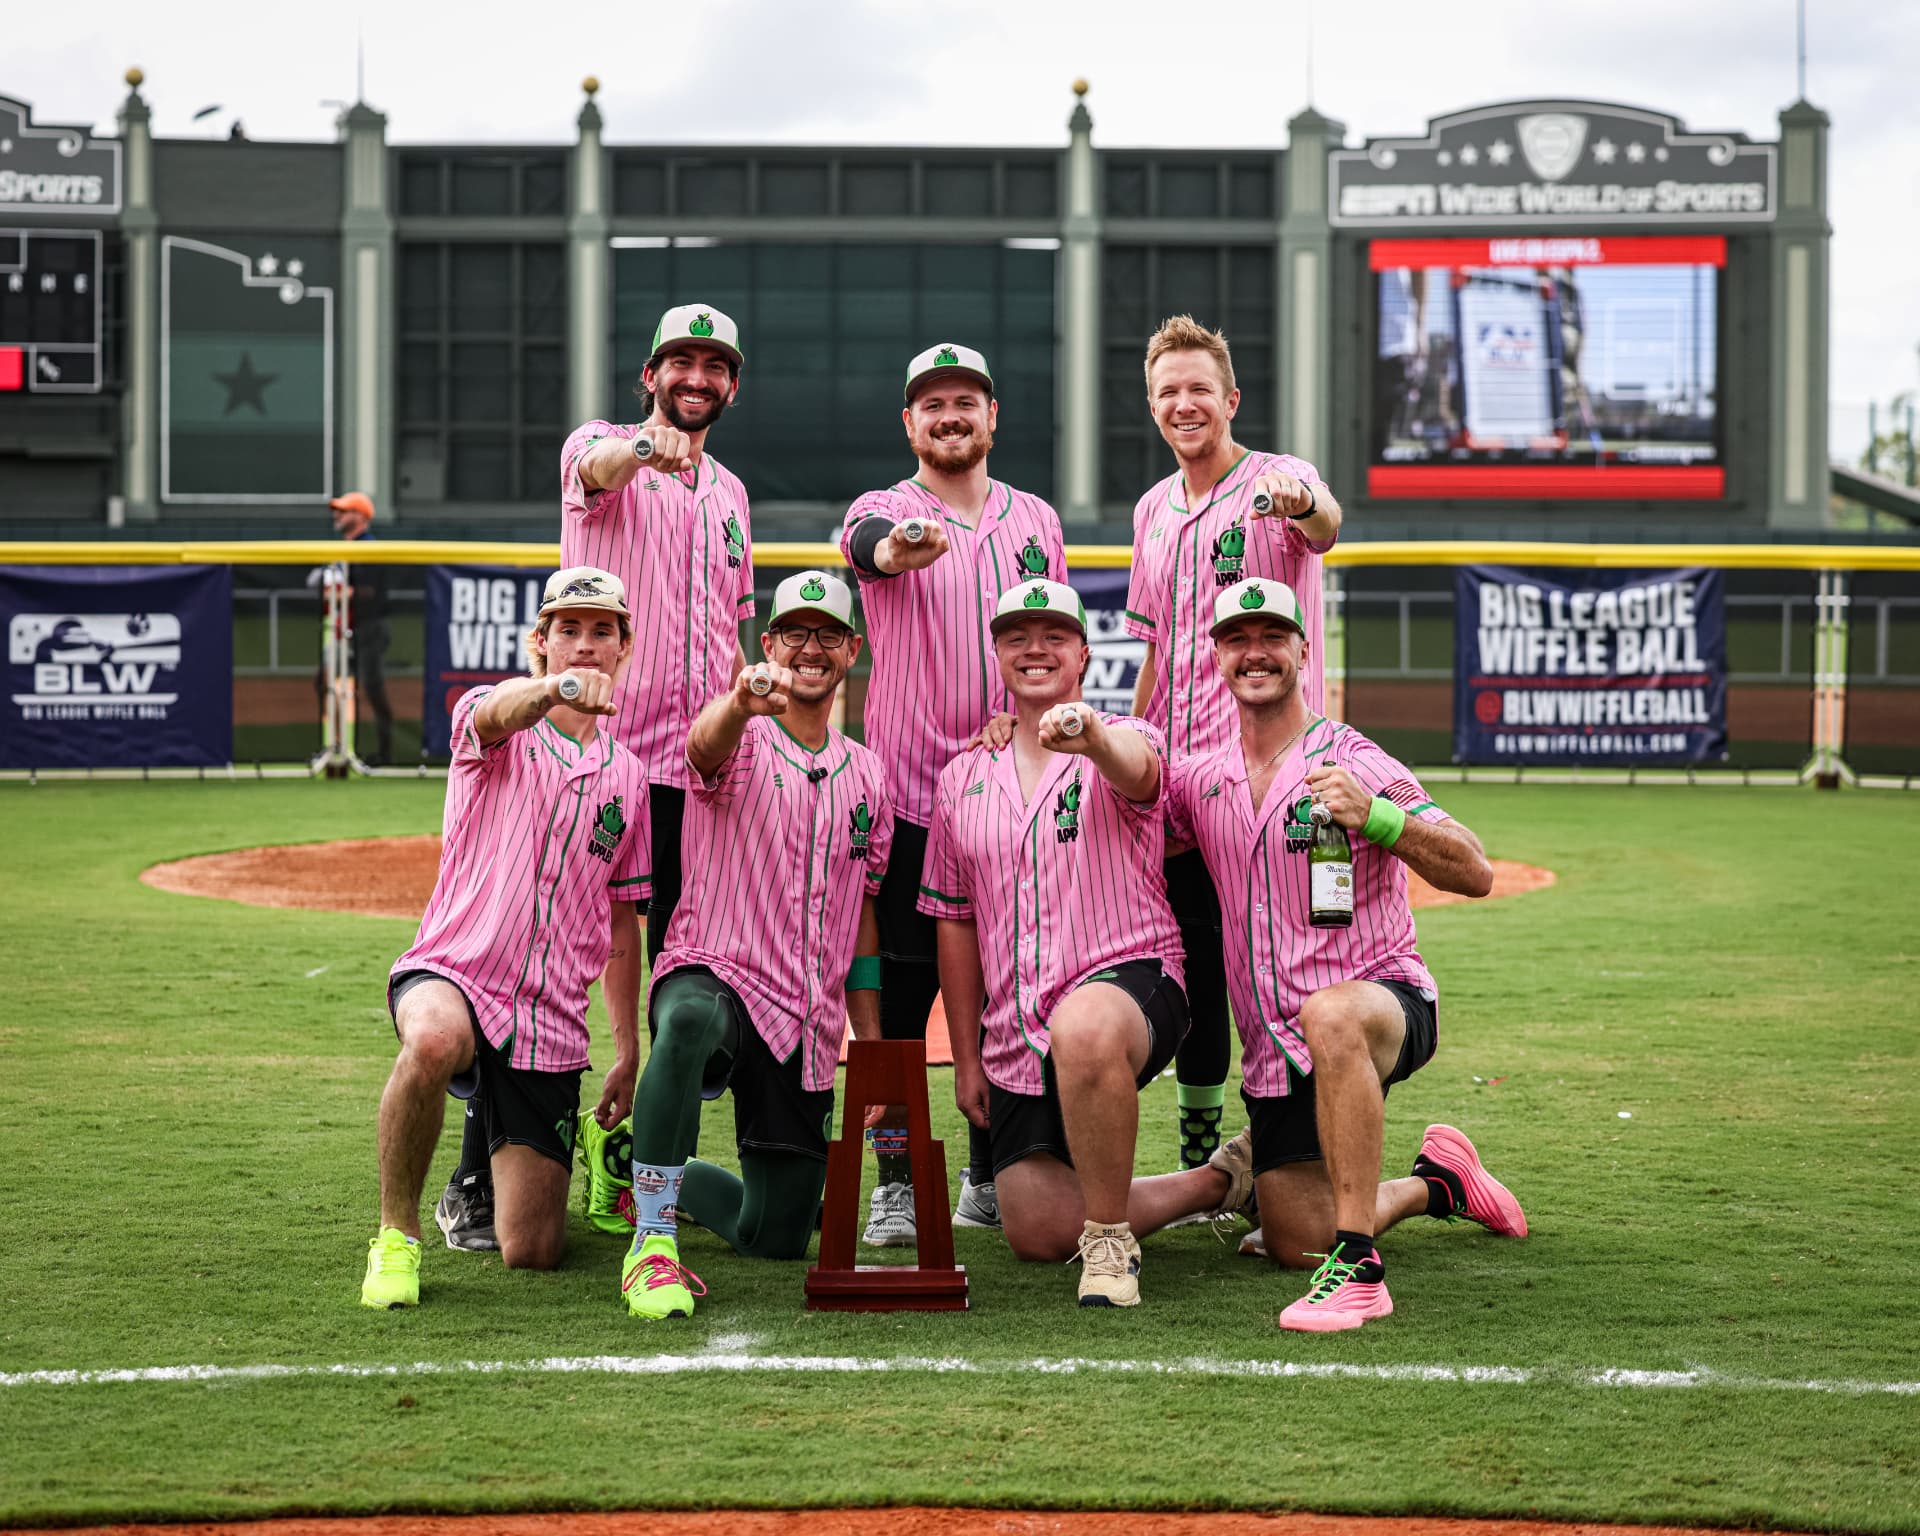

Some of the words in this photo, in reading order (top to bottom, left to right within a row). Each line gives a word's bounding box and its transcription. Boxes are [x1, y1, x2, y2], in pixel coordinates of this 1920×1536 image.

[1439, 183, 1518, 214] WIDE
[1519, 182, 1623, 213] WORLD
[1655, 180, 1764, 211] SPORTS
[1215, 559, 1243, 573] GREE
[451, 577, 516, 622] BIG
[1479, 582, 1543, 627] BIG
[1550, 582, 1696, 629] LEAGUE
[1477, 627, 1608, 674] WIFFLE
[1616, 625, 1706, 674] BALL
[34, 663, 157, 693] BLW
[1057, 827, 1078, 843] APP
[1286, 839, 1311, 854] APP
